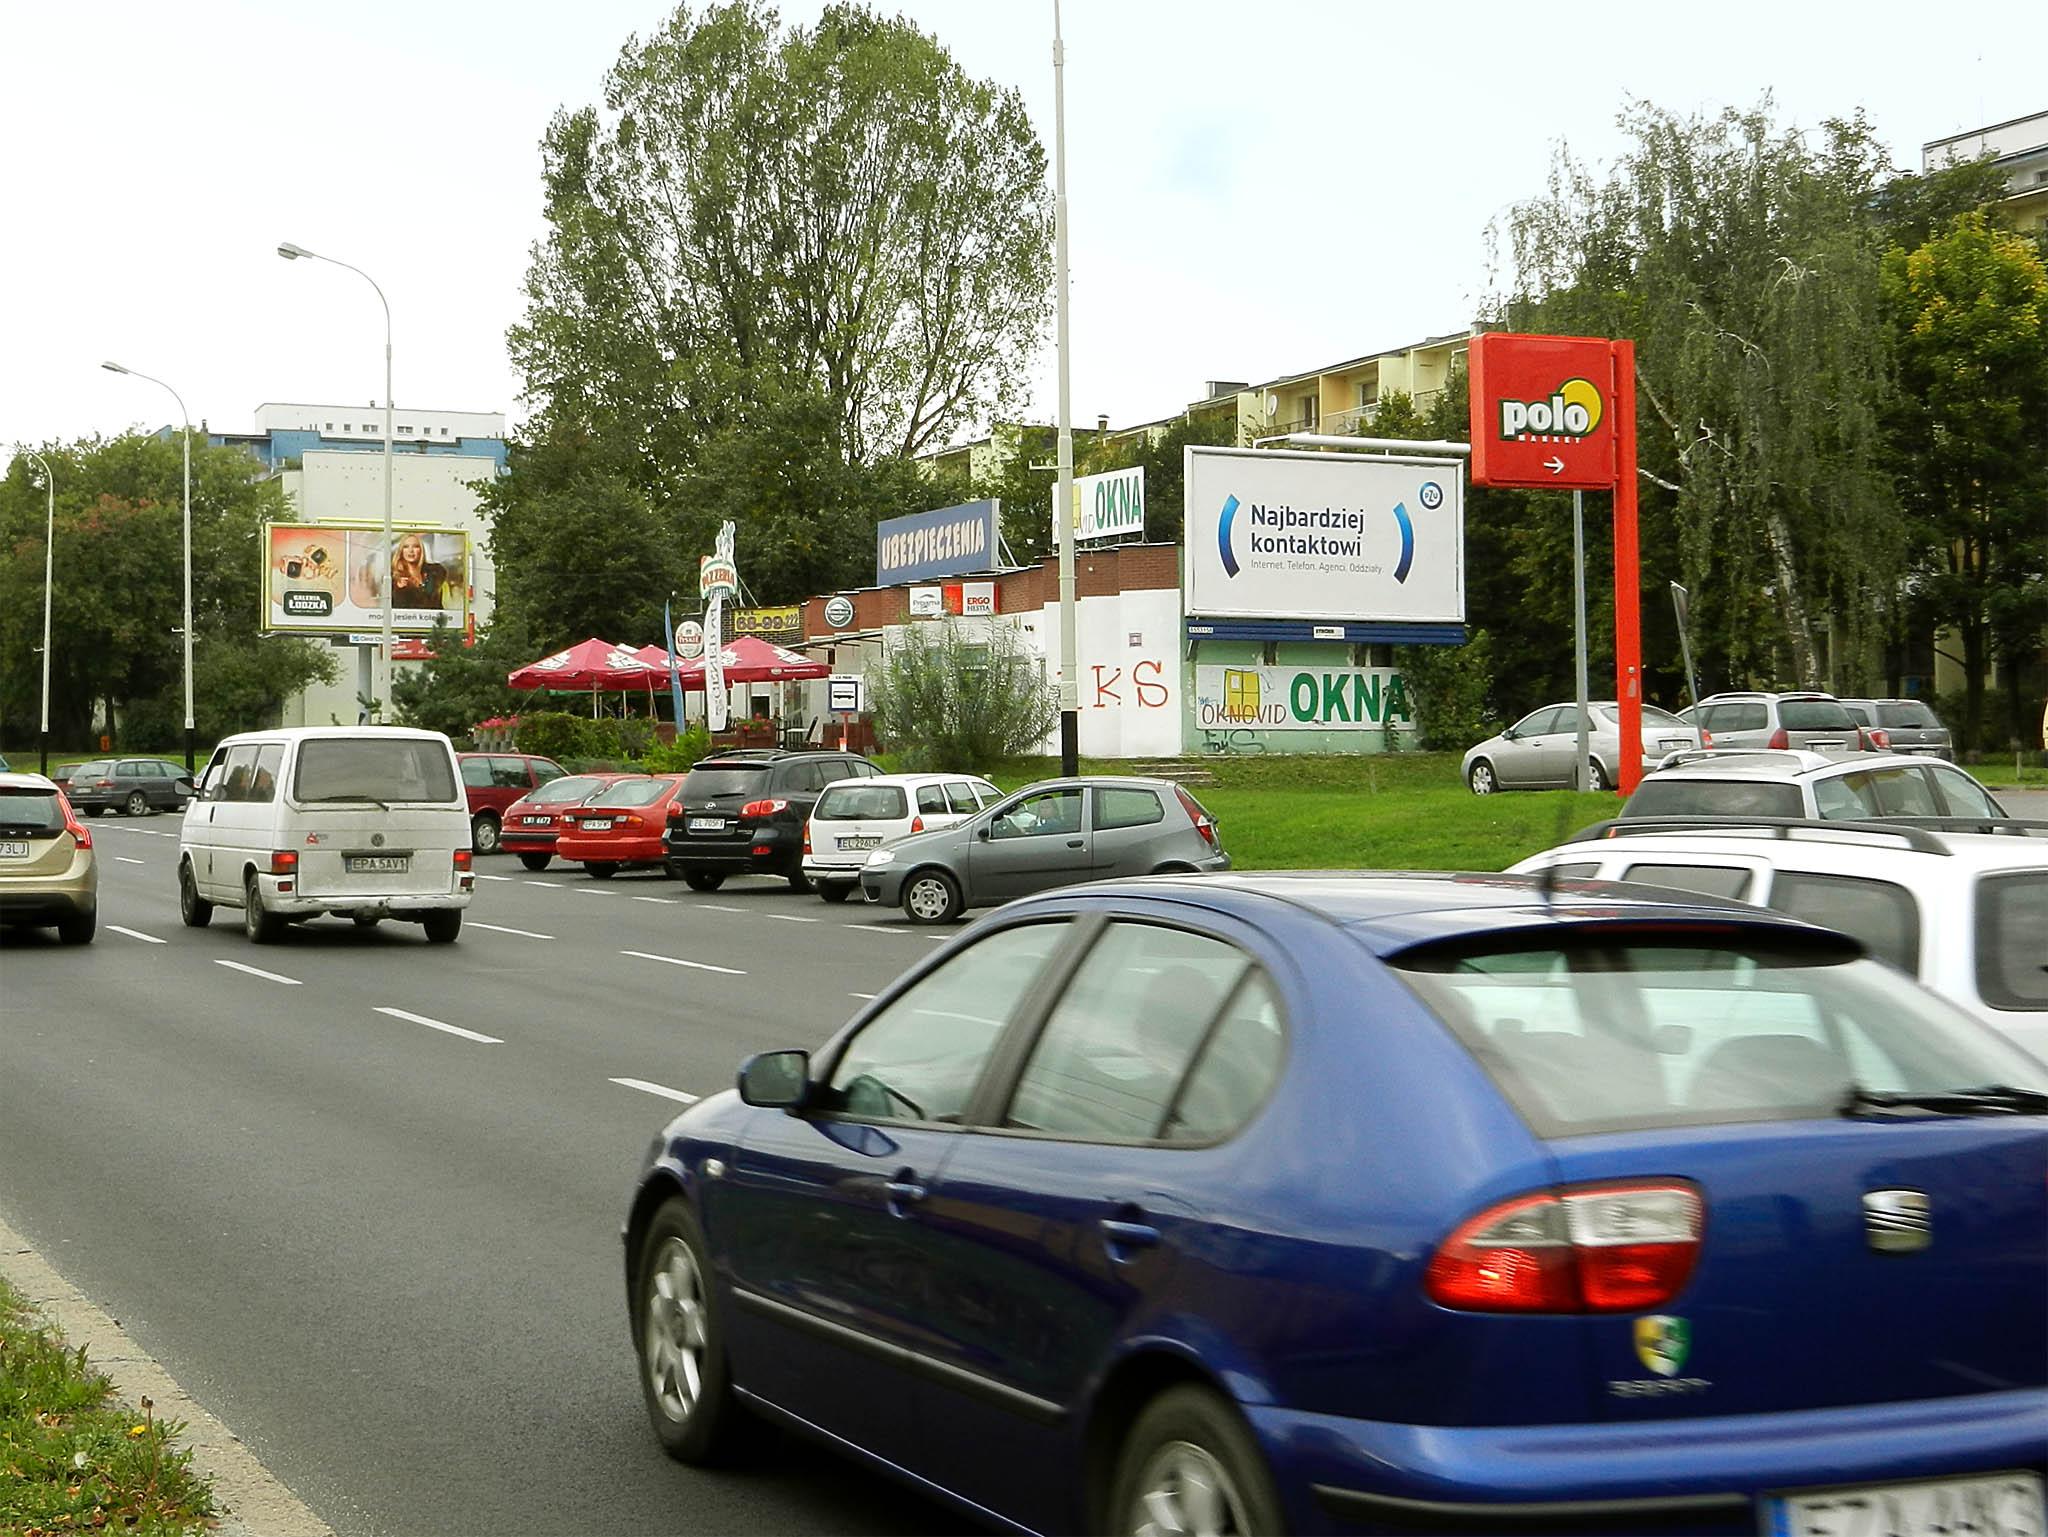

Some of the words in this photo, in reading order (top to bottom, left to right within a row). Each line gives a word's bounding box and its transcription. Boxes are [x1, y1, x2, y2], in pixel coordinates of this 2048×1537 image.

[1502, 396, 1590, 437] polo
[1518, 434, 1581, 444] MARKET
[1095, 475, 1142, 530] OKNA
[1424, 489, 1439, 502] PZU
[1251, 504, 1364, 534] Najbardziej
[882, 517, 985, 570] UBEZPIECZENIA
[1251, 532, 1361, 556] kontaktowi
[702, 568, 736, 590] PIZZERIA
[967, 597, 991, 605] ERGO
[1289, 672, 1411, 723] OKNA
[1201, 703, 1287, 725] OKNOVID
[353, 858, 377, 869] EPA
